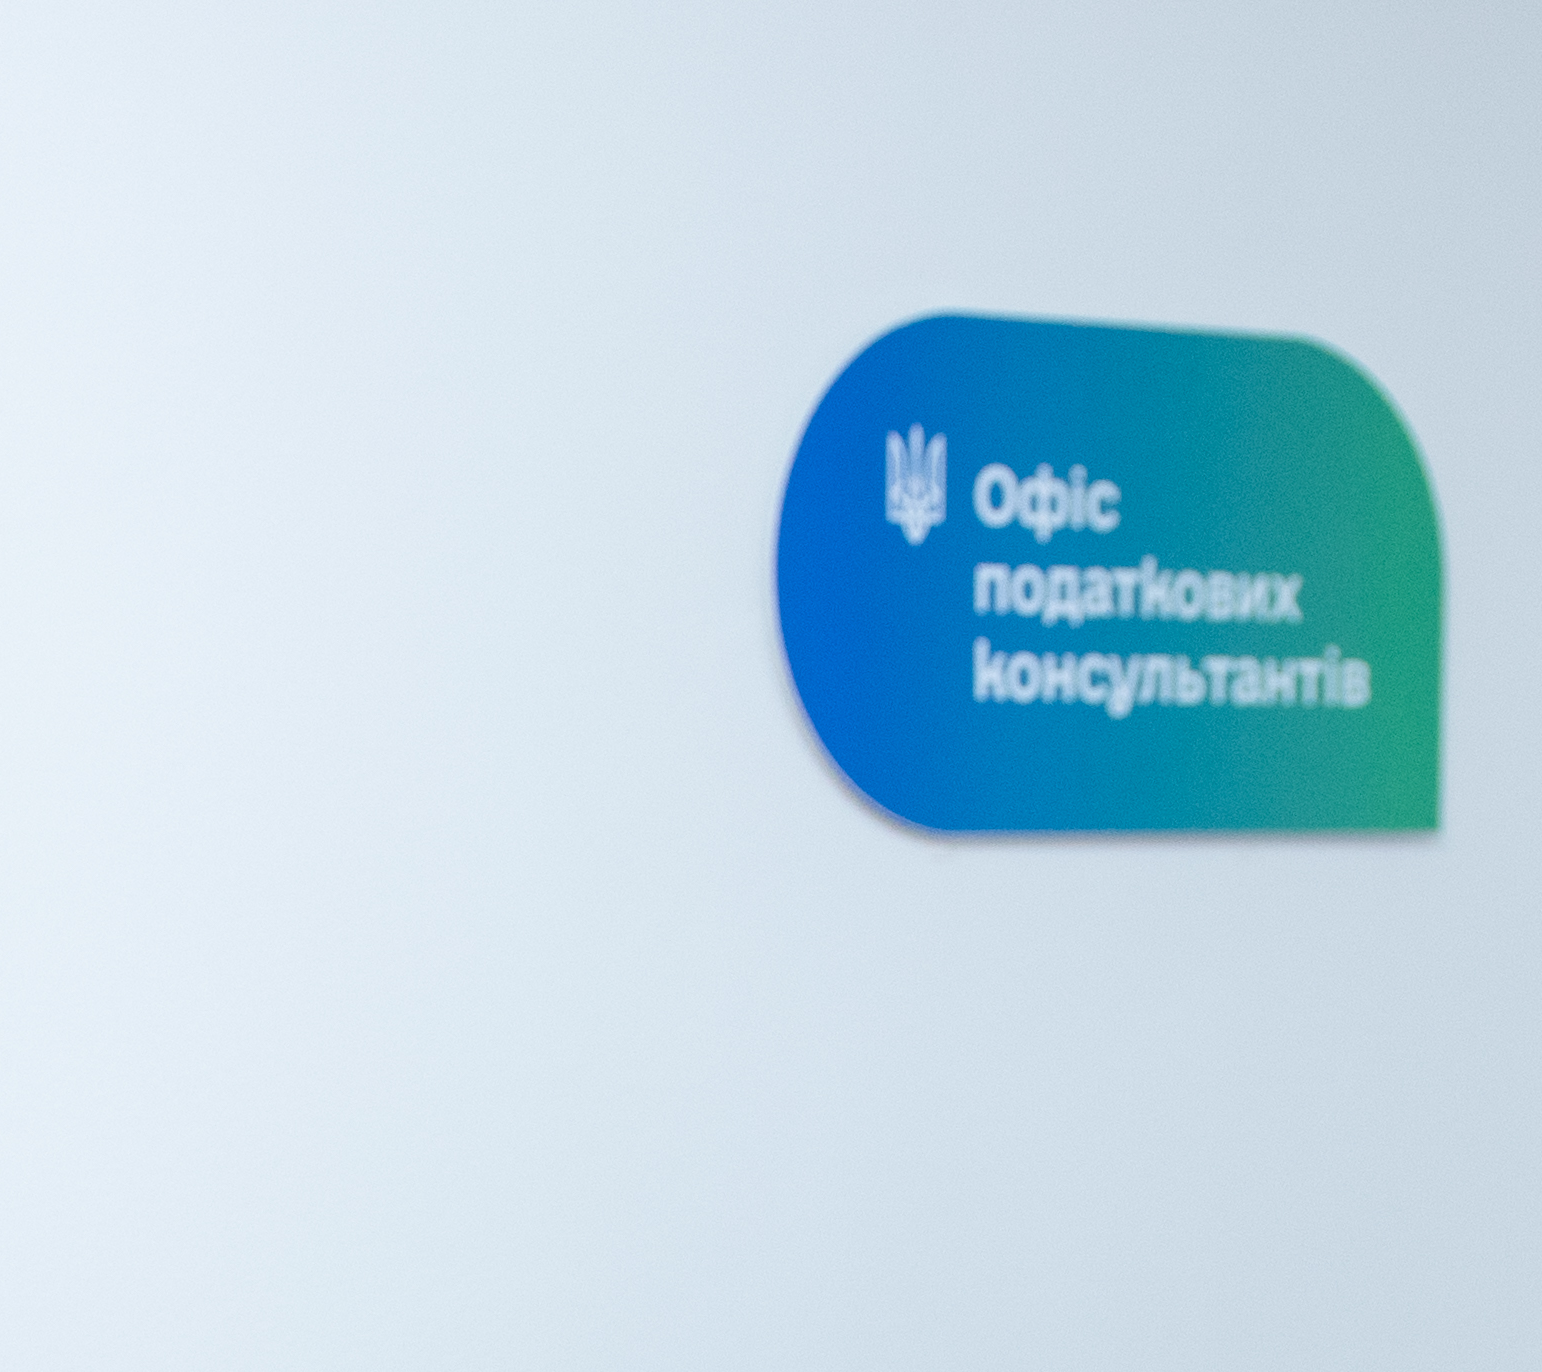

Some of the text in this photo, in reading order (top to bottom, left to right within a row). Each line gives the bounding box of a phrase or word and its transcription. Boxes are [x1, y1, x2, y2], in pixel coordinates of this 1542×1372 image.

[973, 463, 1122, 544] Офіс
[973, 555, 1304, 627] податкових
[973, 637, 1372, 718] консультантів
